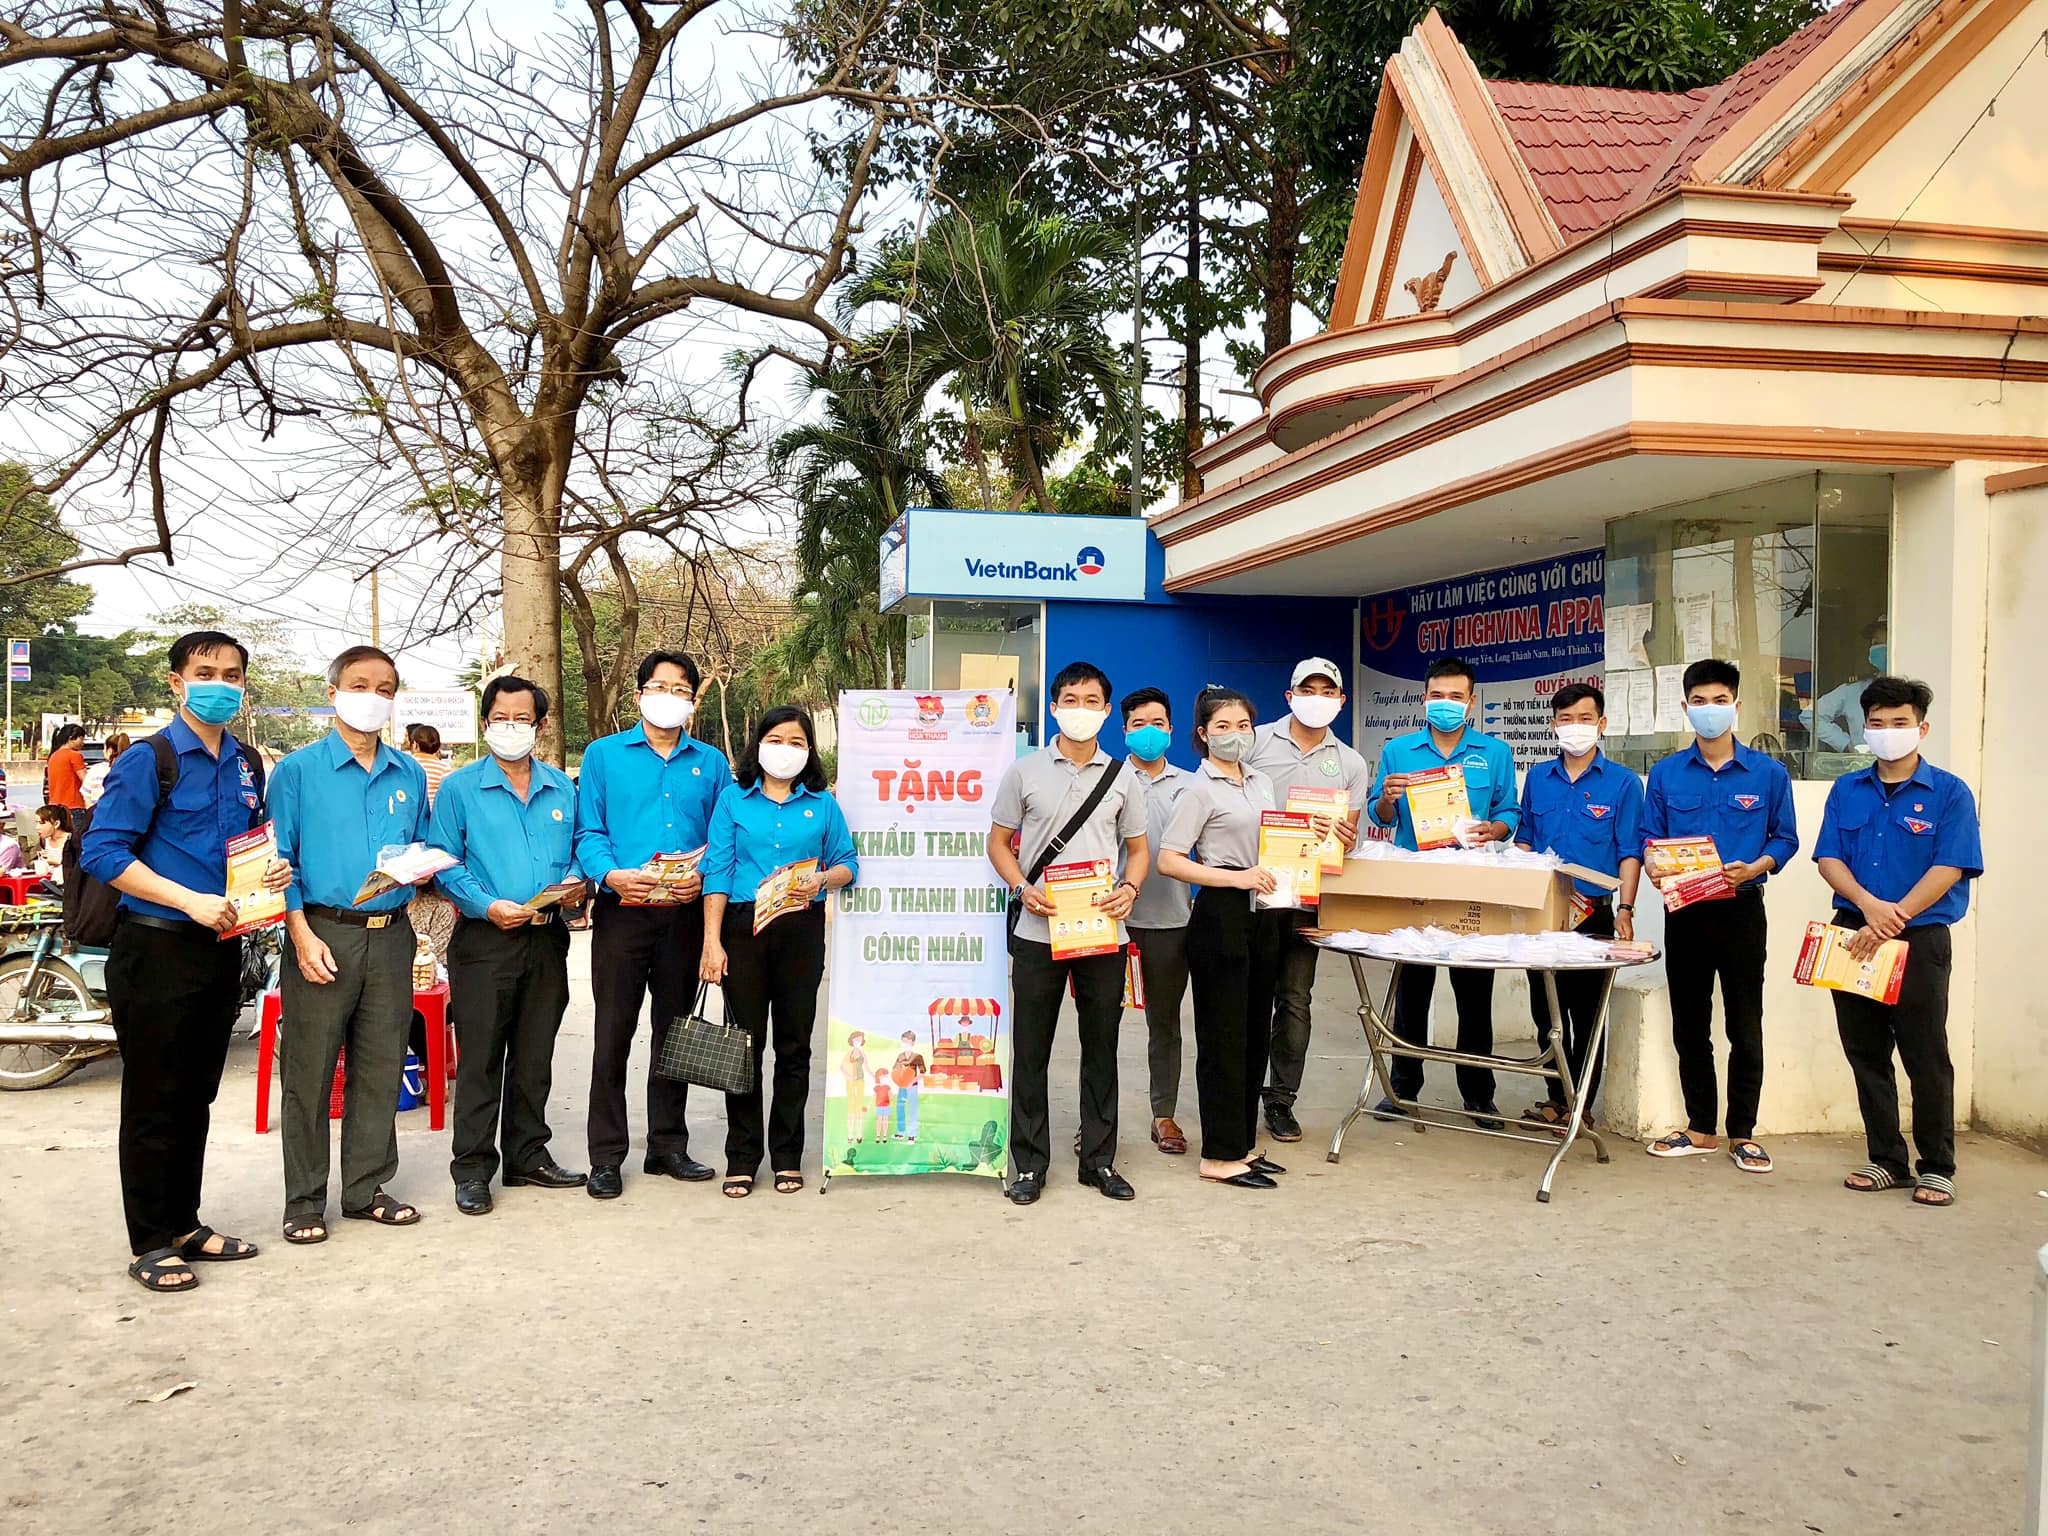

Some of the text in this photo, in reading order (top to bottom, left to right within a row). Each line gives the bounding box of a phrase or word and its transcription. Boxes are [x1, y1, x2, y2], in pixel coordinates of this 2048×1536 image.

[964, 558, 1078, 582] VietinBank
[1411, 590, 1434, 614] HÃY
[1437, 583, 1463, 609] LÀM
[1466, 576, 1496, 605] VIỆC
[1499, 571, 1538, 599] CÙNG
[1541, 561, 1566, 592] VỚI
[1417, 618, 1450, 653] CTY
[1453, 604, 1542, 649] HIGHVINA
[871, 758, 984, 814] TẶNG
[852, 822, 916, 857] KHẨU
[839, 883, 1007, 913] CHO THANH NIÊN
[863, 931, 983, 962] CÔNG NHÂN
